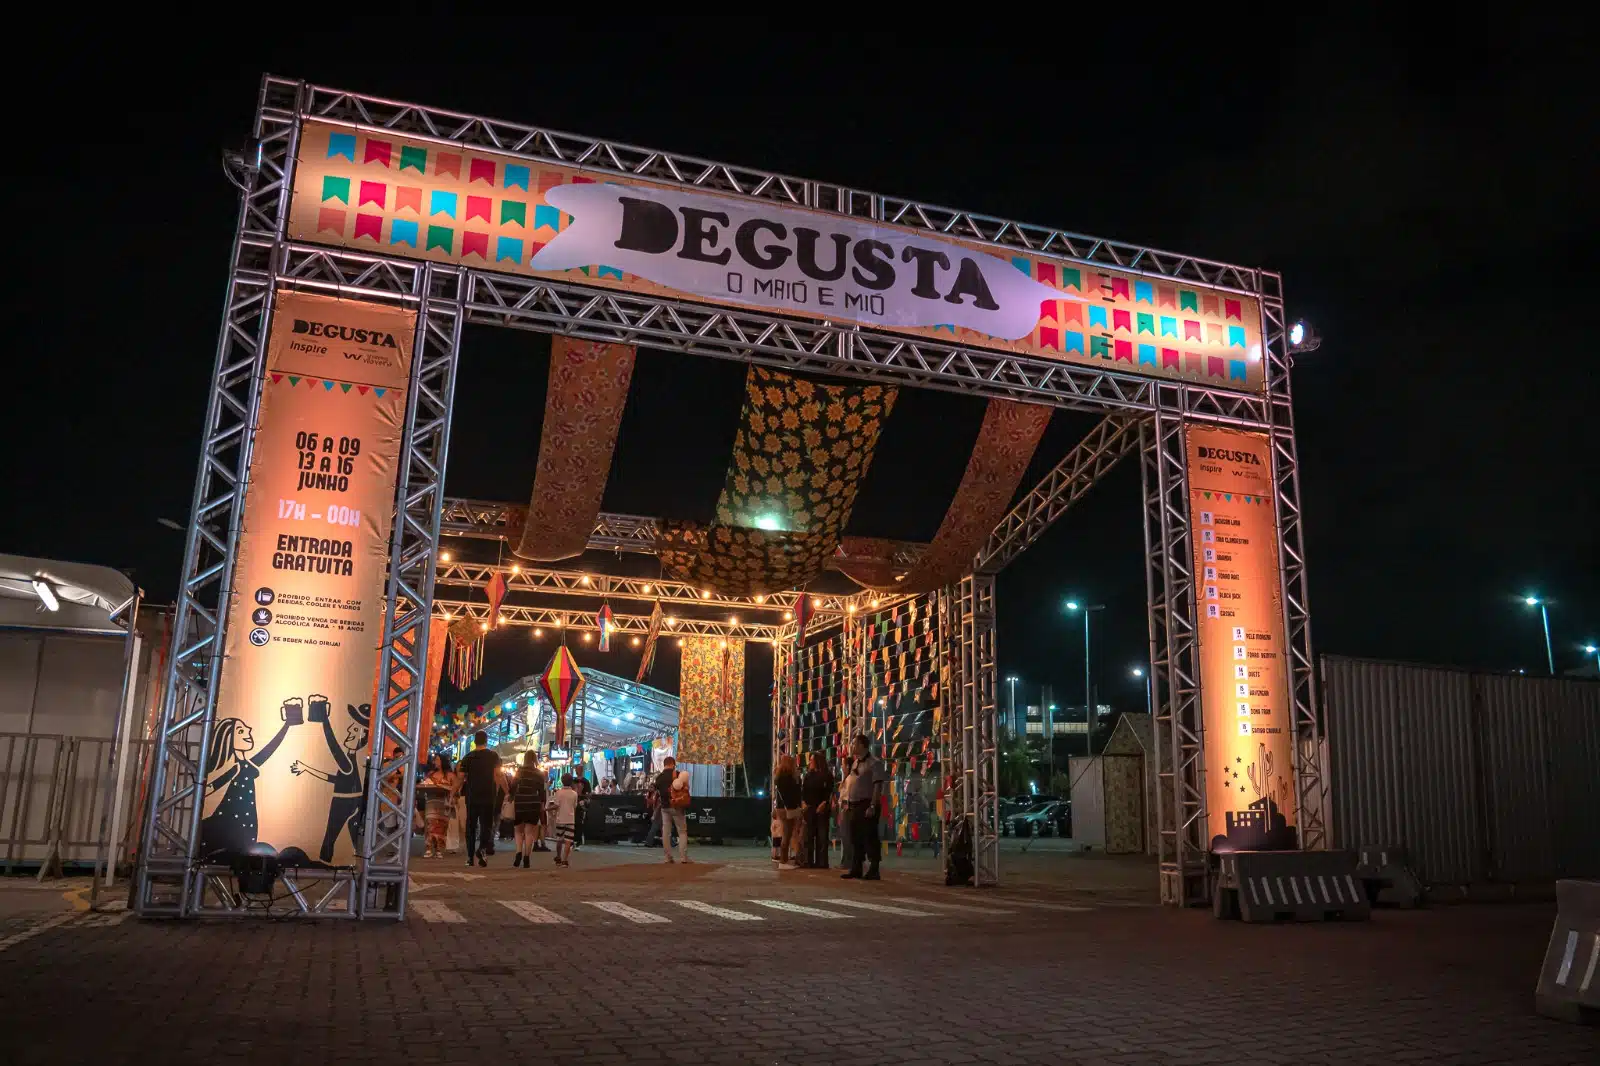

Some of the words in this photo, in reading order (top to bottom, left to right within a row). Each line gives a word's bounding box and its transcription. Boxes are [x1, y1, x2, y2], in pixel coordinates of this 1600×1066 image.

[614, 196, 1000, 311] DEGUSTA
[727, 272, 742, 294] O
[818, 287, 834, 306] E
[292, 319, 397, 348] DEGUSTA
[295, 430, 319, 451] 06
[322, 437, 334, 453] A
[339, 436, 360, 456] 09
[1197, 446, 1260, 465] DEGUSTA
[298, 451, 315, 470] 13
[320, 456, 331, 473] A
[337, 455, 355, 476] 16
[296, 471, 349, 493] JUNHO
[278, 498, 306, 521] 17H
[327, 504, 360, 527] 00H
[277, 533, 352, 558] ENTRADA
[272, 552, 353, 577] GRATUITA
[278, 593, 310, 601] PROIBIDO
